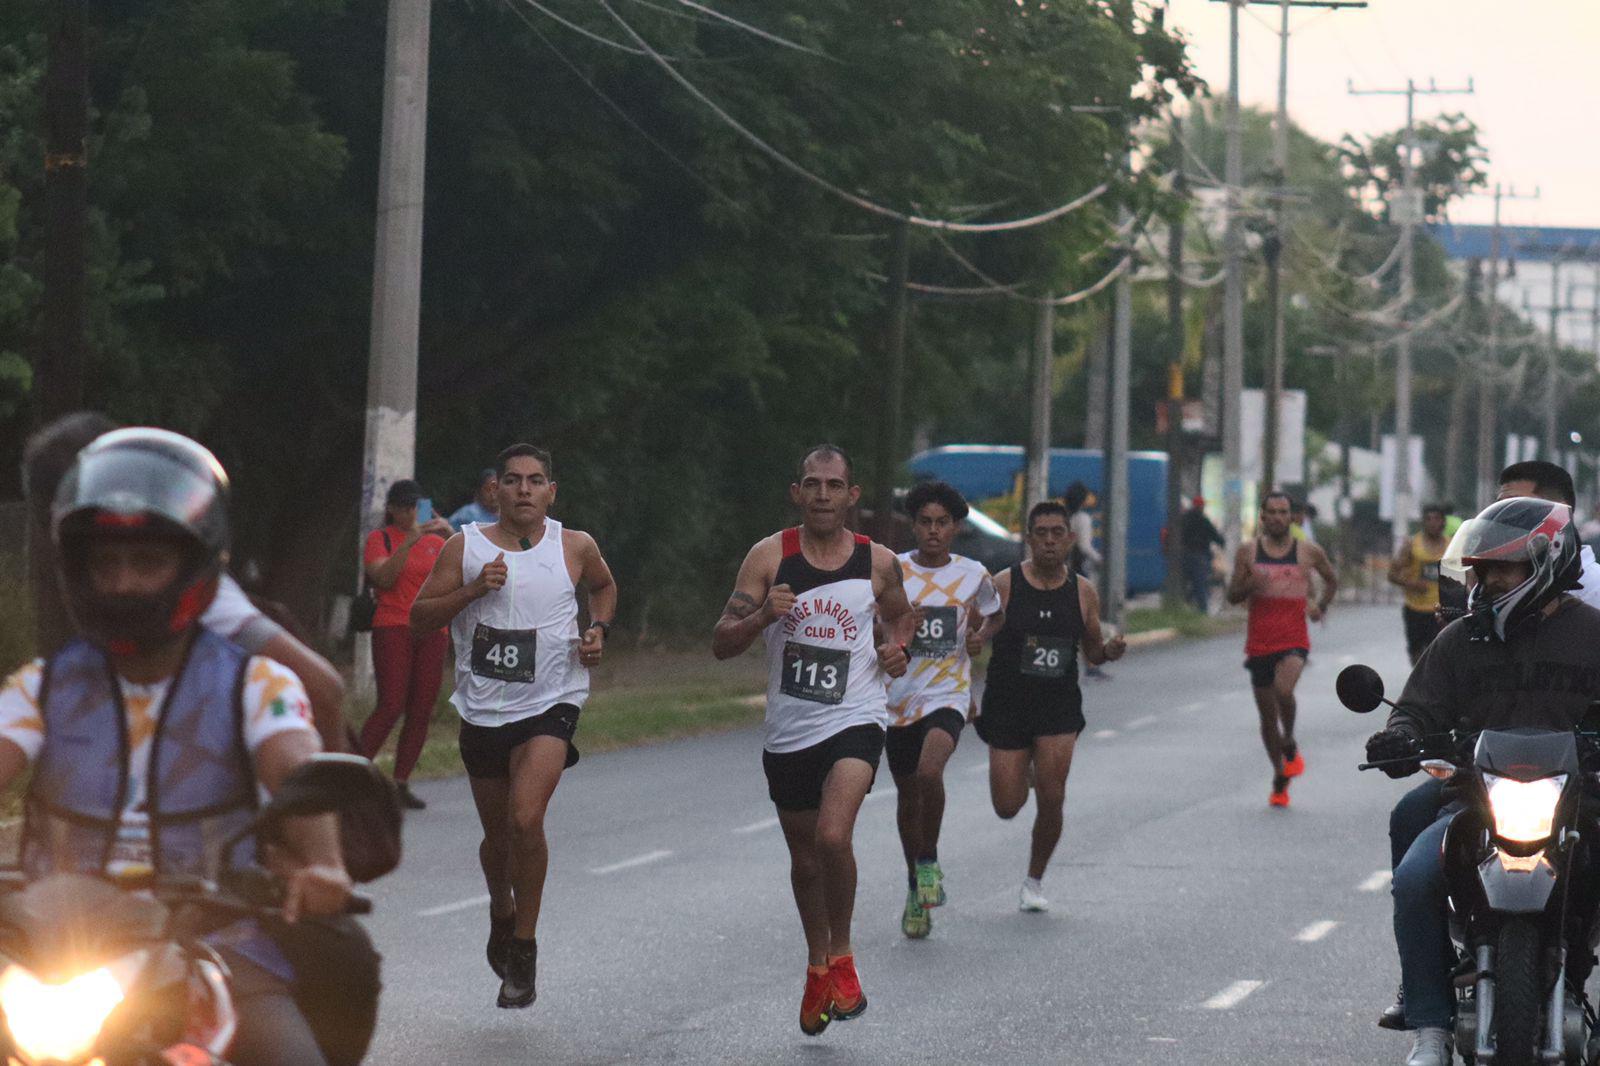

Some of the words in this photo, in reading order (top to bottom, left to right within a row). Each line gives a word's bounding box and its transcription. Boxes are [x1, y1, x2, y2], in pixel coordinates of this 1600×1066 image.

[783, 602, 812, 637] JORGE
[916, 618, 944, 639] 36
[804, 626, 836, 639] CLUB
[485, 643, 519, 668] 48
[1032, 647, 1060, 667] 26
[791, 659, 838, 689] 113
